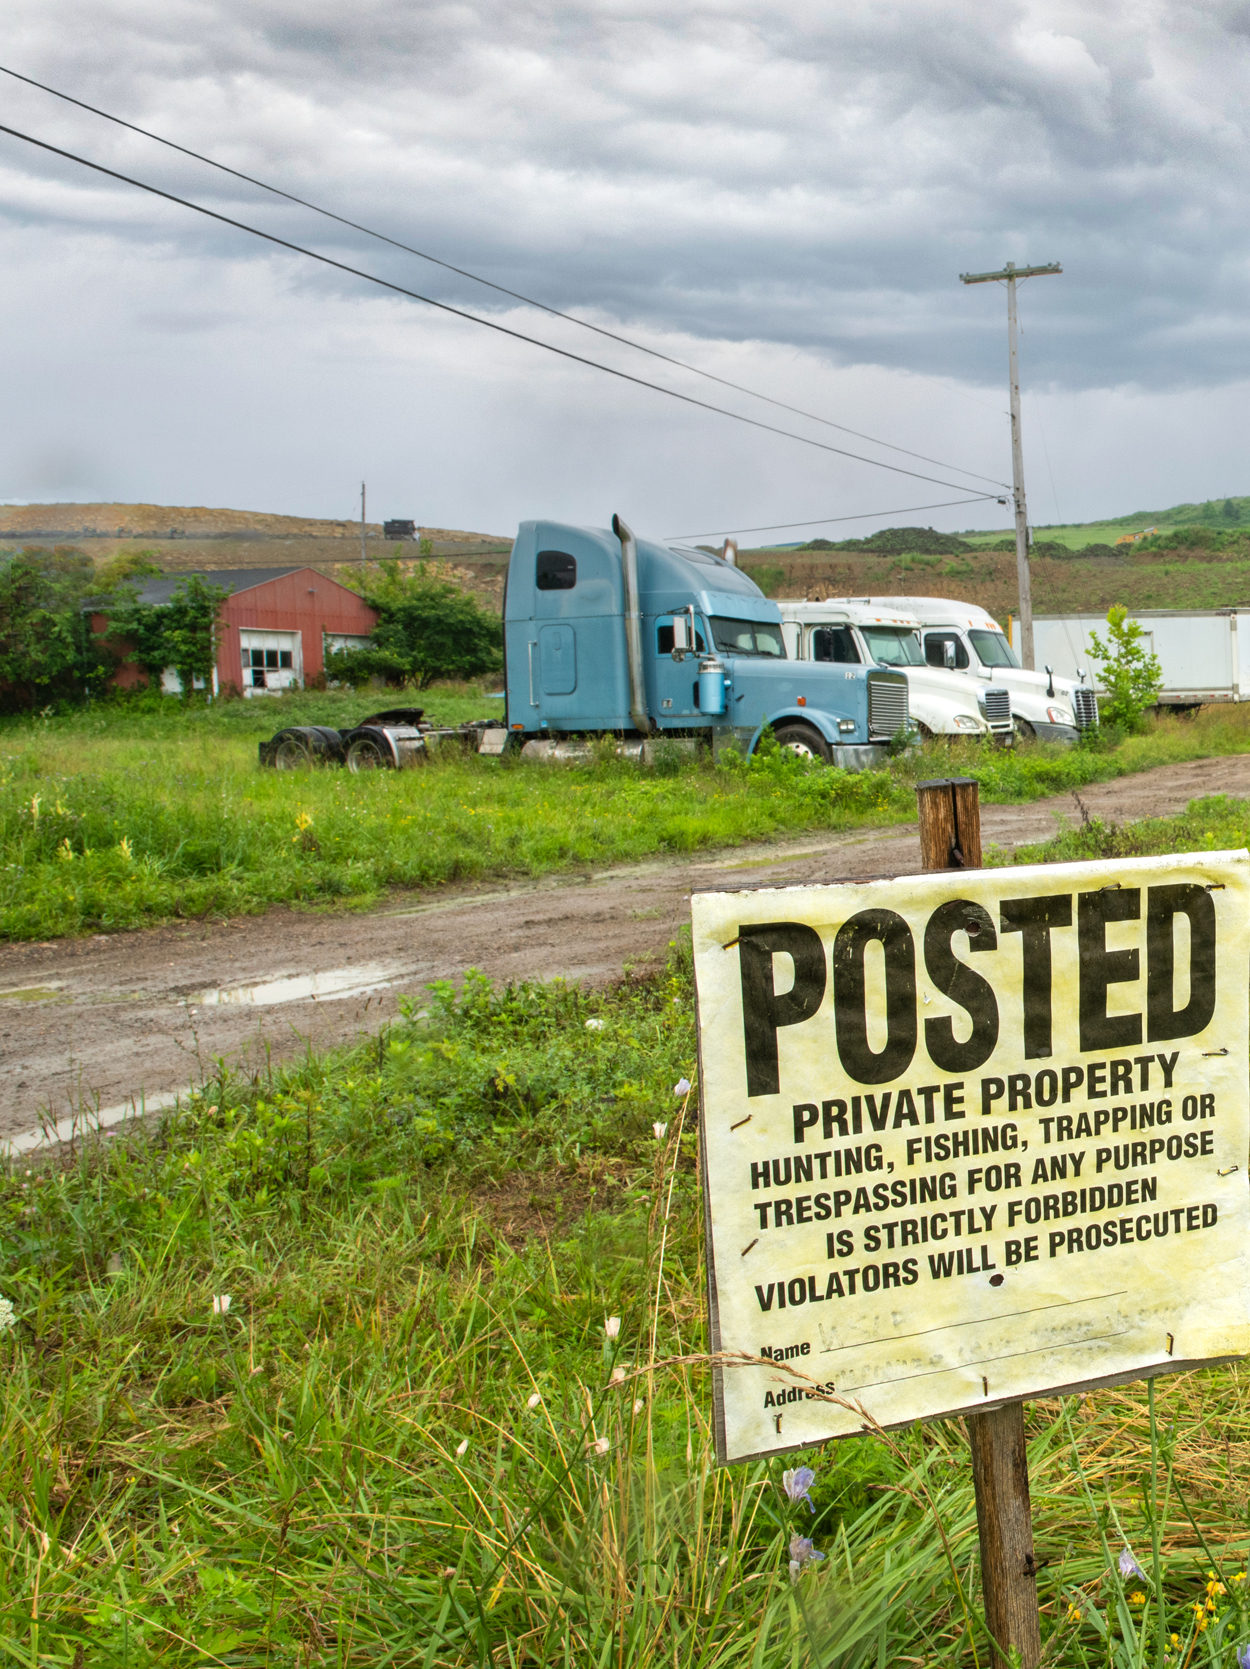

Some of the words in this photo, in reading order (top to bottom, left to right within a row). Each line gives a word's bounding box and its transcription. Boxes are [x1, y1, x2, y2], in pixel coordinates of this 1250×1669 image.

[738, 883, 1217, 1098] POSTED
[751, 1143, 895, 1190] HUNTING,
[906, 1123, 1030, 1166] FISHING,
[1039, 1100, 1171, 1144] TRAPPING
[1182, 1093, 1216, 1121] OR
[792, 1082, 965, 1143] PRIVATE
[981, 1052, 1181, 1115] PROPERTY
[754, 1173, 957, 1230] TRESPASSING
[968, 1162, 1022, 1196] FOR
[1031, 1151, 1085, 1185] ANY
[1096, 1130, 1214, 1173] PURPOSE
[826, 1230, 853, 1259] IS
[863, 1203, 996, 1253] STRICTLY
[1007, 1176, 1158, 1228] FORBIDDEN
[755, 1259, 918, 1312] VIOLATORS
[928, 1243, 996, 1280] WILL
[1005, 1235, 1040, 1266] BE
[1049, 1203, 1218, 1258] PROSECUTED
[760, 1341, 811, 1362] Name
